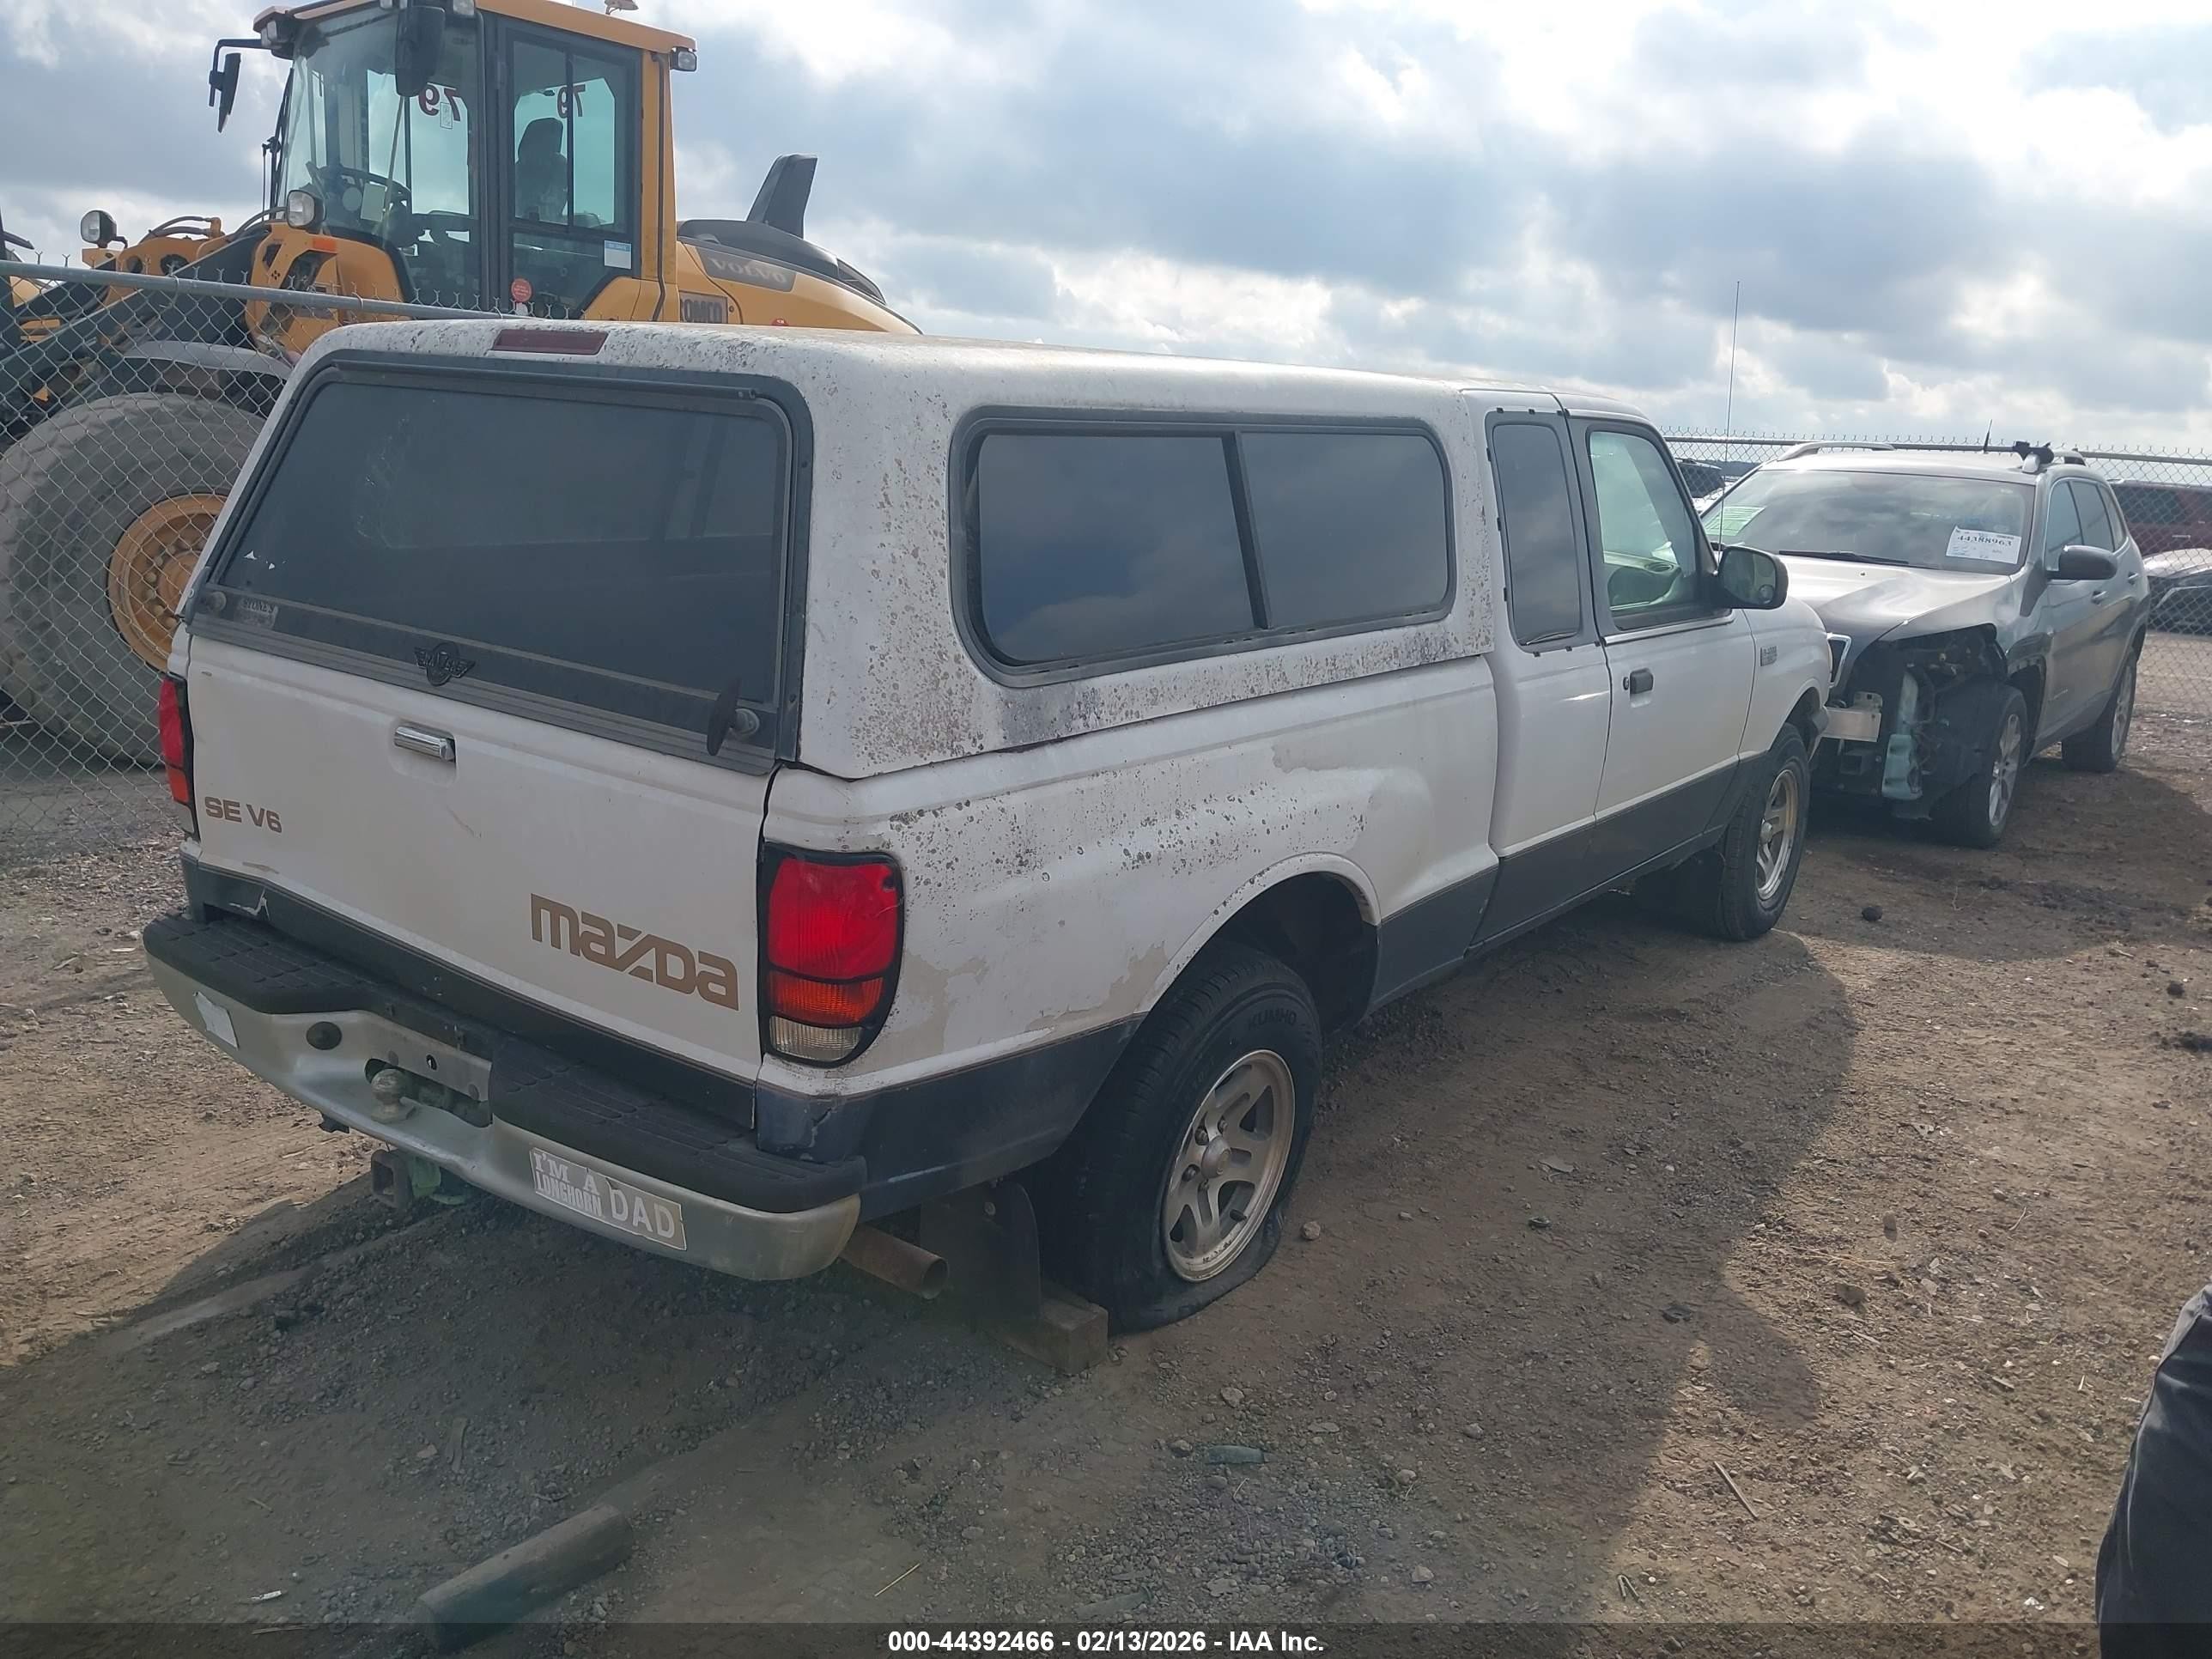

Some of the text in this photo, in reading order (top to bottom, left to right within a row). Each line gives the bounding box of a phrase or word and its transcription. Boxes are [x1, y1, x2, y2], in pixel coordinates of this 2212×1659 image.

[710, 258, 787, 283] VOLVO
[204, 795, 283, 835] SE V6
[534, 1152, 600, 1196] I'M A
[536, 1170, 675, 1238] LONGHORN DAD
